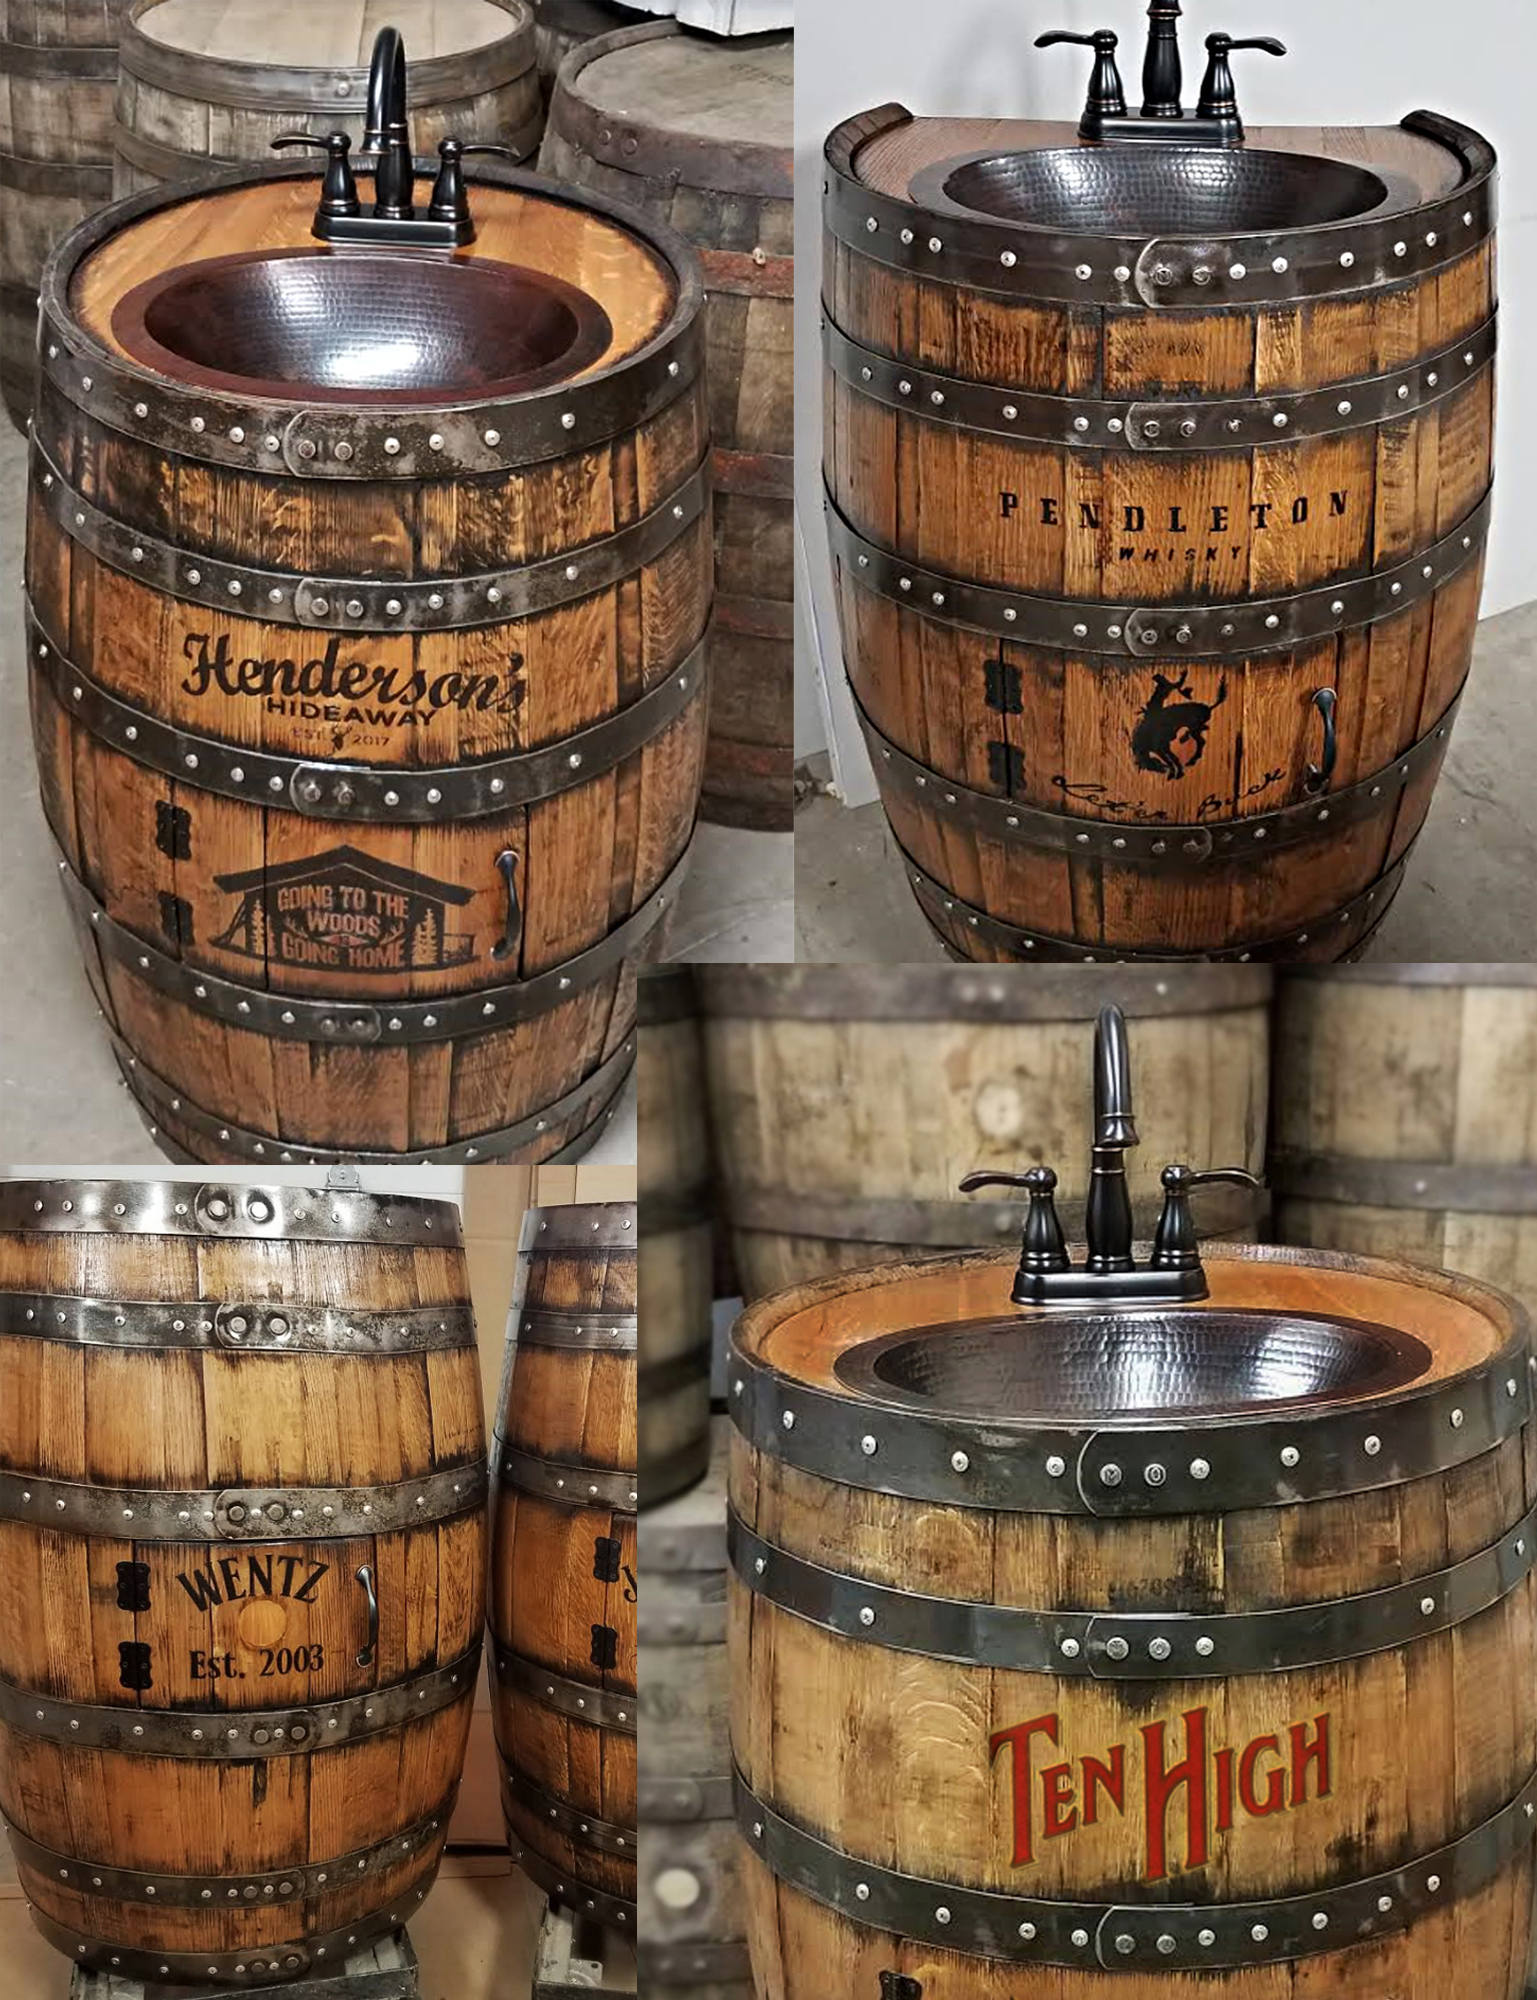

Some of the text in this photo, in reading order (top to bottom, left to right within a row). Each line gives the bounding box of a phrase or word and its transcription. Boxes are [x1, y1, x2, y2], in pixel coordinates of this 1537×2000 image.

[1000, 490, 1349, 533] PENDLETON
[1118, 547, 1243, 563] WHISKY
[182, 632, 527, 713] Henderson's
[266, 696, 440, 727] HIDEAWAY
[352, 734, 391, 747] 2017
[277, 885, 409, 919] GOING TO THE
[306, 910, 381, 938] WOODS
[281, 931, 406, 968] GOING HOME
[175, 1554, 330, 1612] WENTZ
[189, 1644, 325, 1680] Est. 2003
